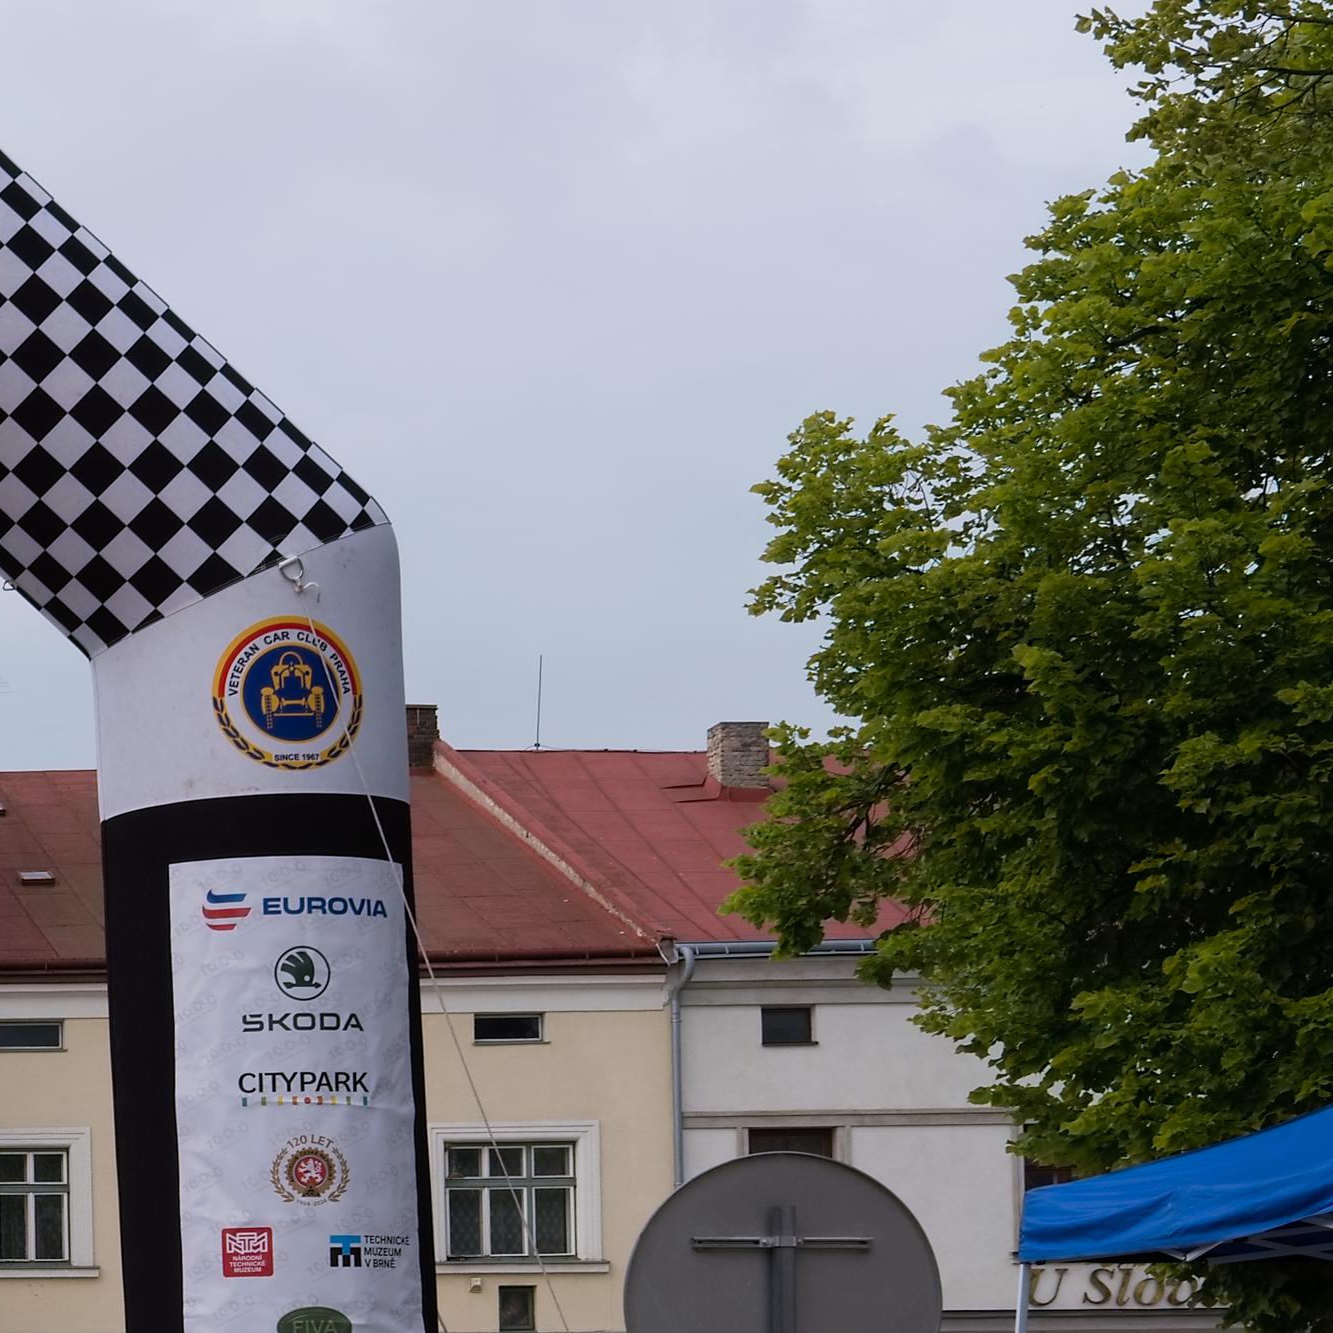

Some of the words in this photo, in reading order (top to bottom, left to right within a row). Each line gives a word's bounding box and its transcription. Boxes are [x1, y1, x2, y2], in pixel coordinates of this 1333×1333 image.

[228, 643, 260, 696] VETERAN
[263, 631, 290, 645] CAR
[297, 631, 328, 652] CLUB
[329, 653, 351, 695] PRAHA
[274, 754, 300, 762] SINCE
[302, 753, 320, 761] 1967
[262, 896, 388, 919] EUROVIA
[238, 1071, 370, 1094] CITYPARK
[287, 1135, 308, 1149] 120
[311, 1134, 334, 1149] LET
[364, 1235, 410, 1246] TECHNICKÉ
[364, 1247, 402, 1257] MUZEUM
[364, 1258, 372, 1268] V
[373, 1257, 397, 1269] BRNĚ
[1029, 1268, 1069, 1307] U
